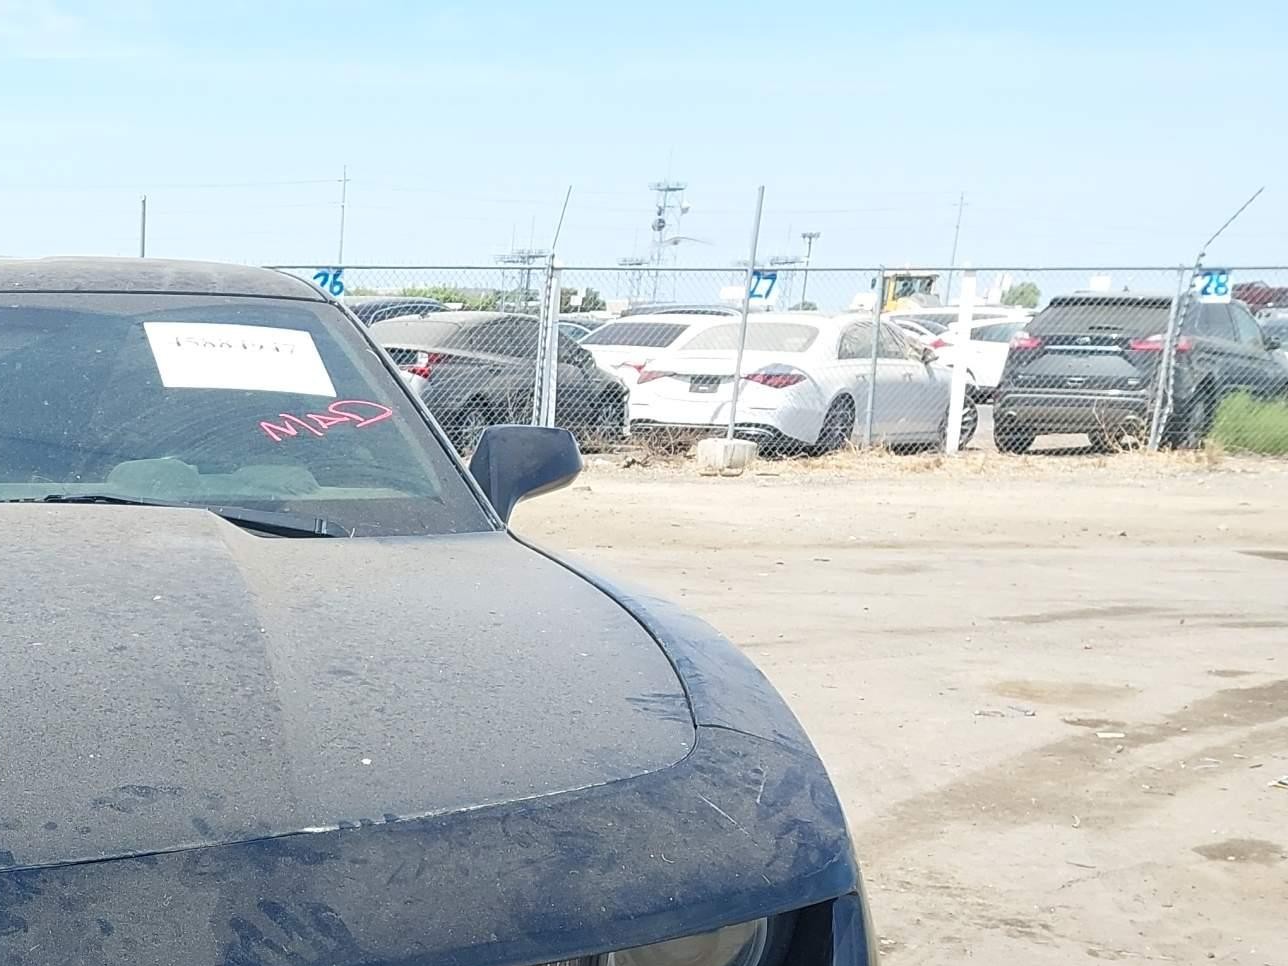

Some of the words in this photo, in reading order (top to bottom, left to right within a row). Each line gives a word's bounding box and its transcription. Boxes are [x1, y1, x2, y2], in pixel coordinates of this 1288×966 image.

[313, 269, 344, 297] 26
[748, 270, 778, 300] 27
[1200, 270, 1229, 297] 28
[259, 400, 393, 442] MAD
